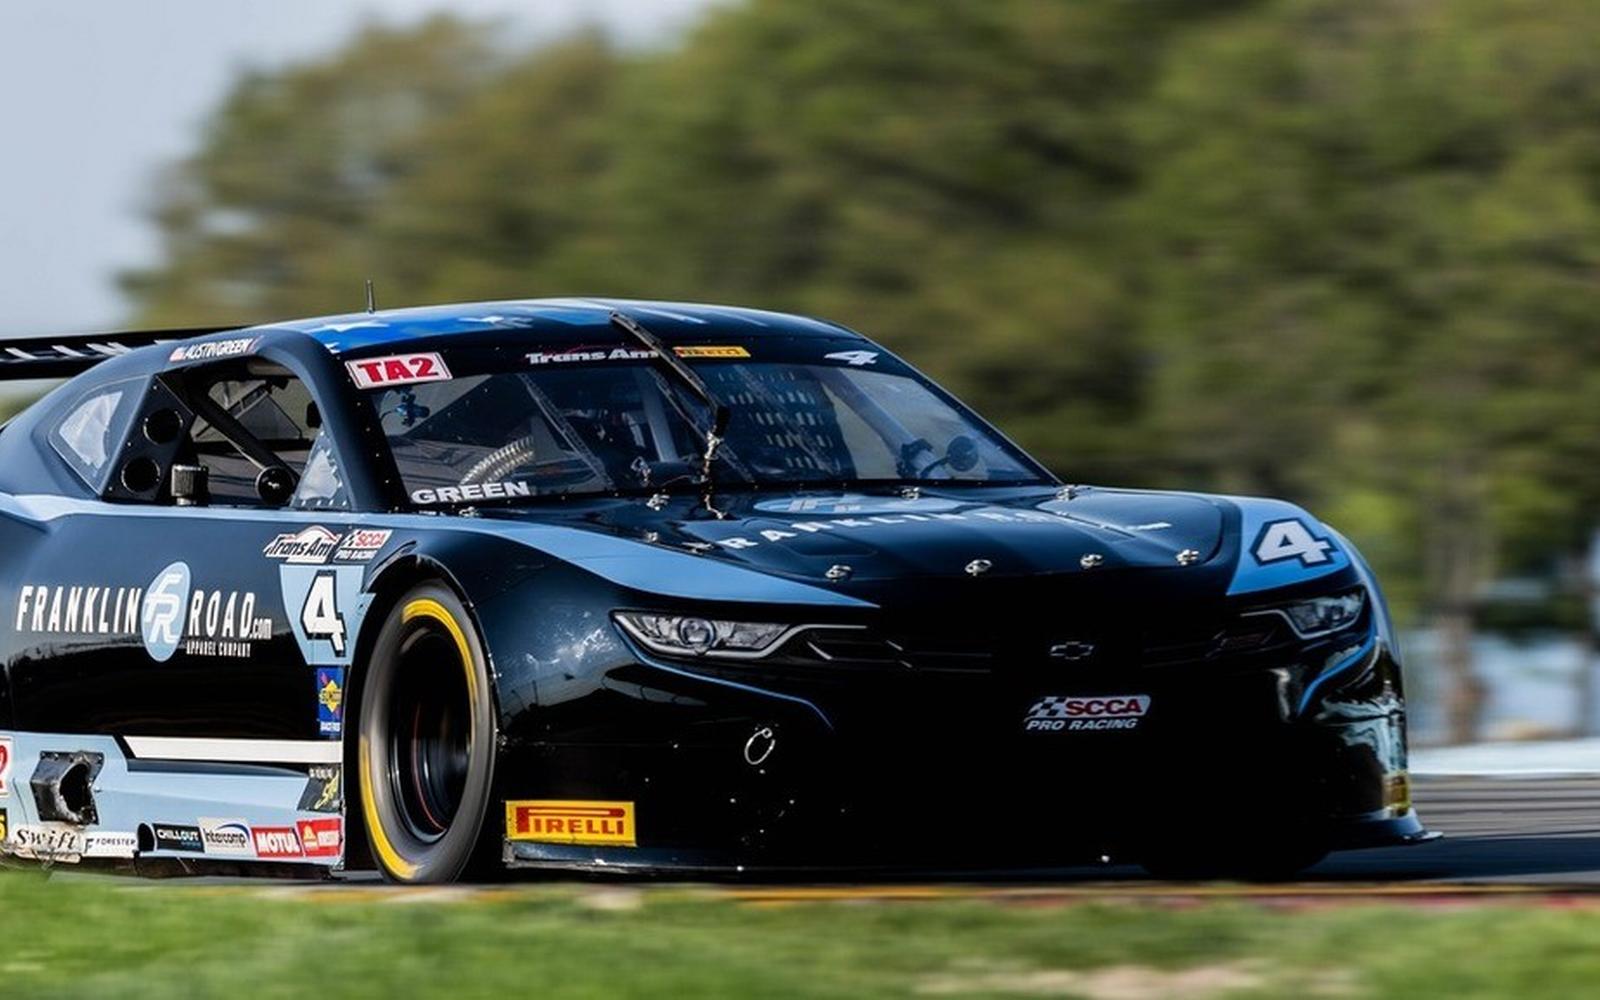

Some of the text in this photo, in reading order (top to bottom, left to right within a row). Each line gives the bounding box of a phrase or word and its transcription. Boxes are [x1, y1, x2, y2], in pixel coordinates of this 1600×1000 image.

[217, 338, 253, 356] GREEN
[526, 348, 659, 364] Trans Am
[824, 350, 879, 366] 4
[358, 357, 440, 384] TA2
[411, 481, 531, 504] GREEN
[265, 537, 333, 557] Trans Am
[1254, 518, 1333, 566] 4
[16, 586, 143, 634] FRANKLIN
[301, 570, 347, 657] 4
[1065, 699, 1143, 716] SCCA
[1026, 718, 1139, 731] PRO RACING
[515, 806, 626, 836] PIRELLI
[14, 829, 77, 851] Swift
[96, 838, 137, 846] FORESTER
[203, 828, 247, 848] Intercomp
[256, 832, 300, 853] MOTUL
